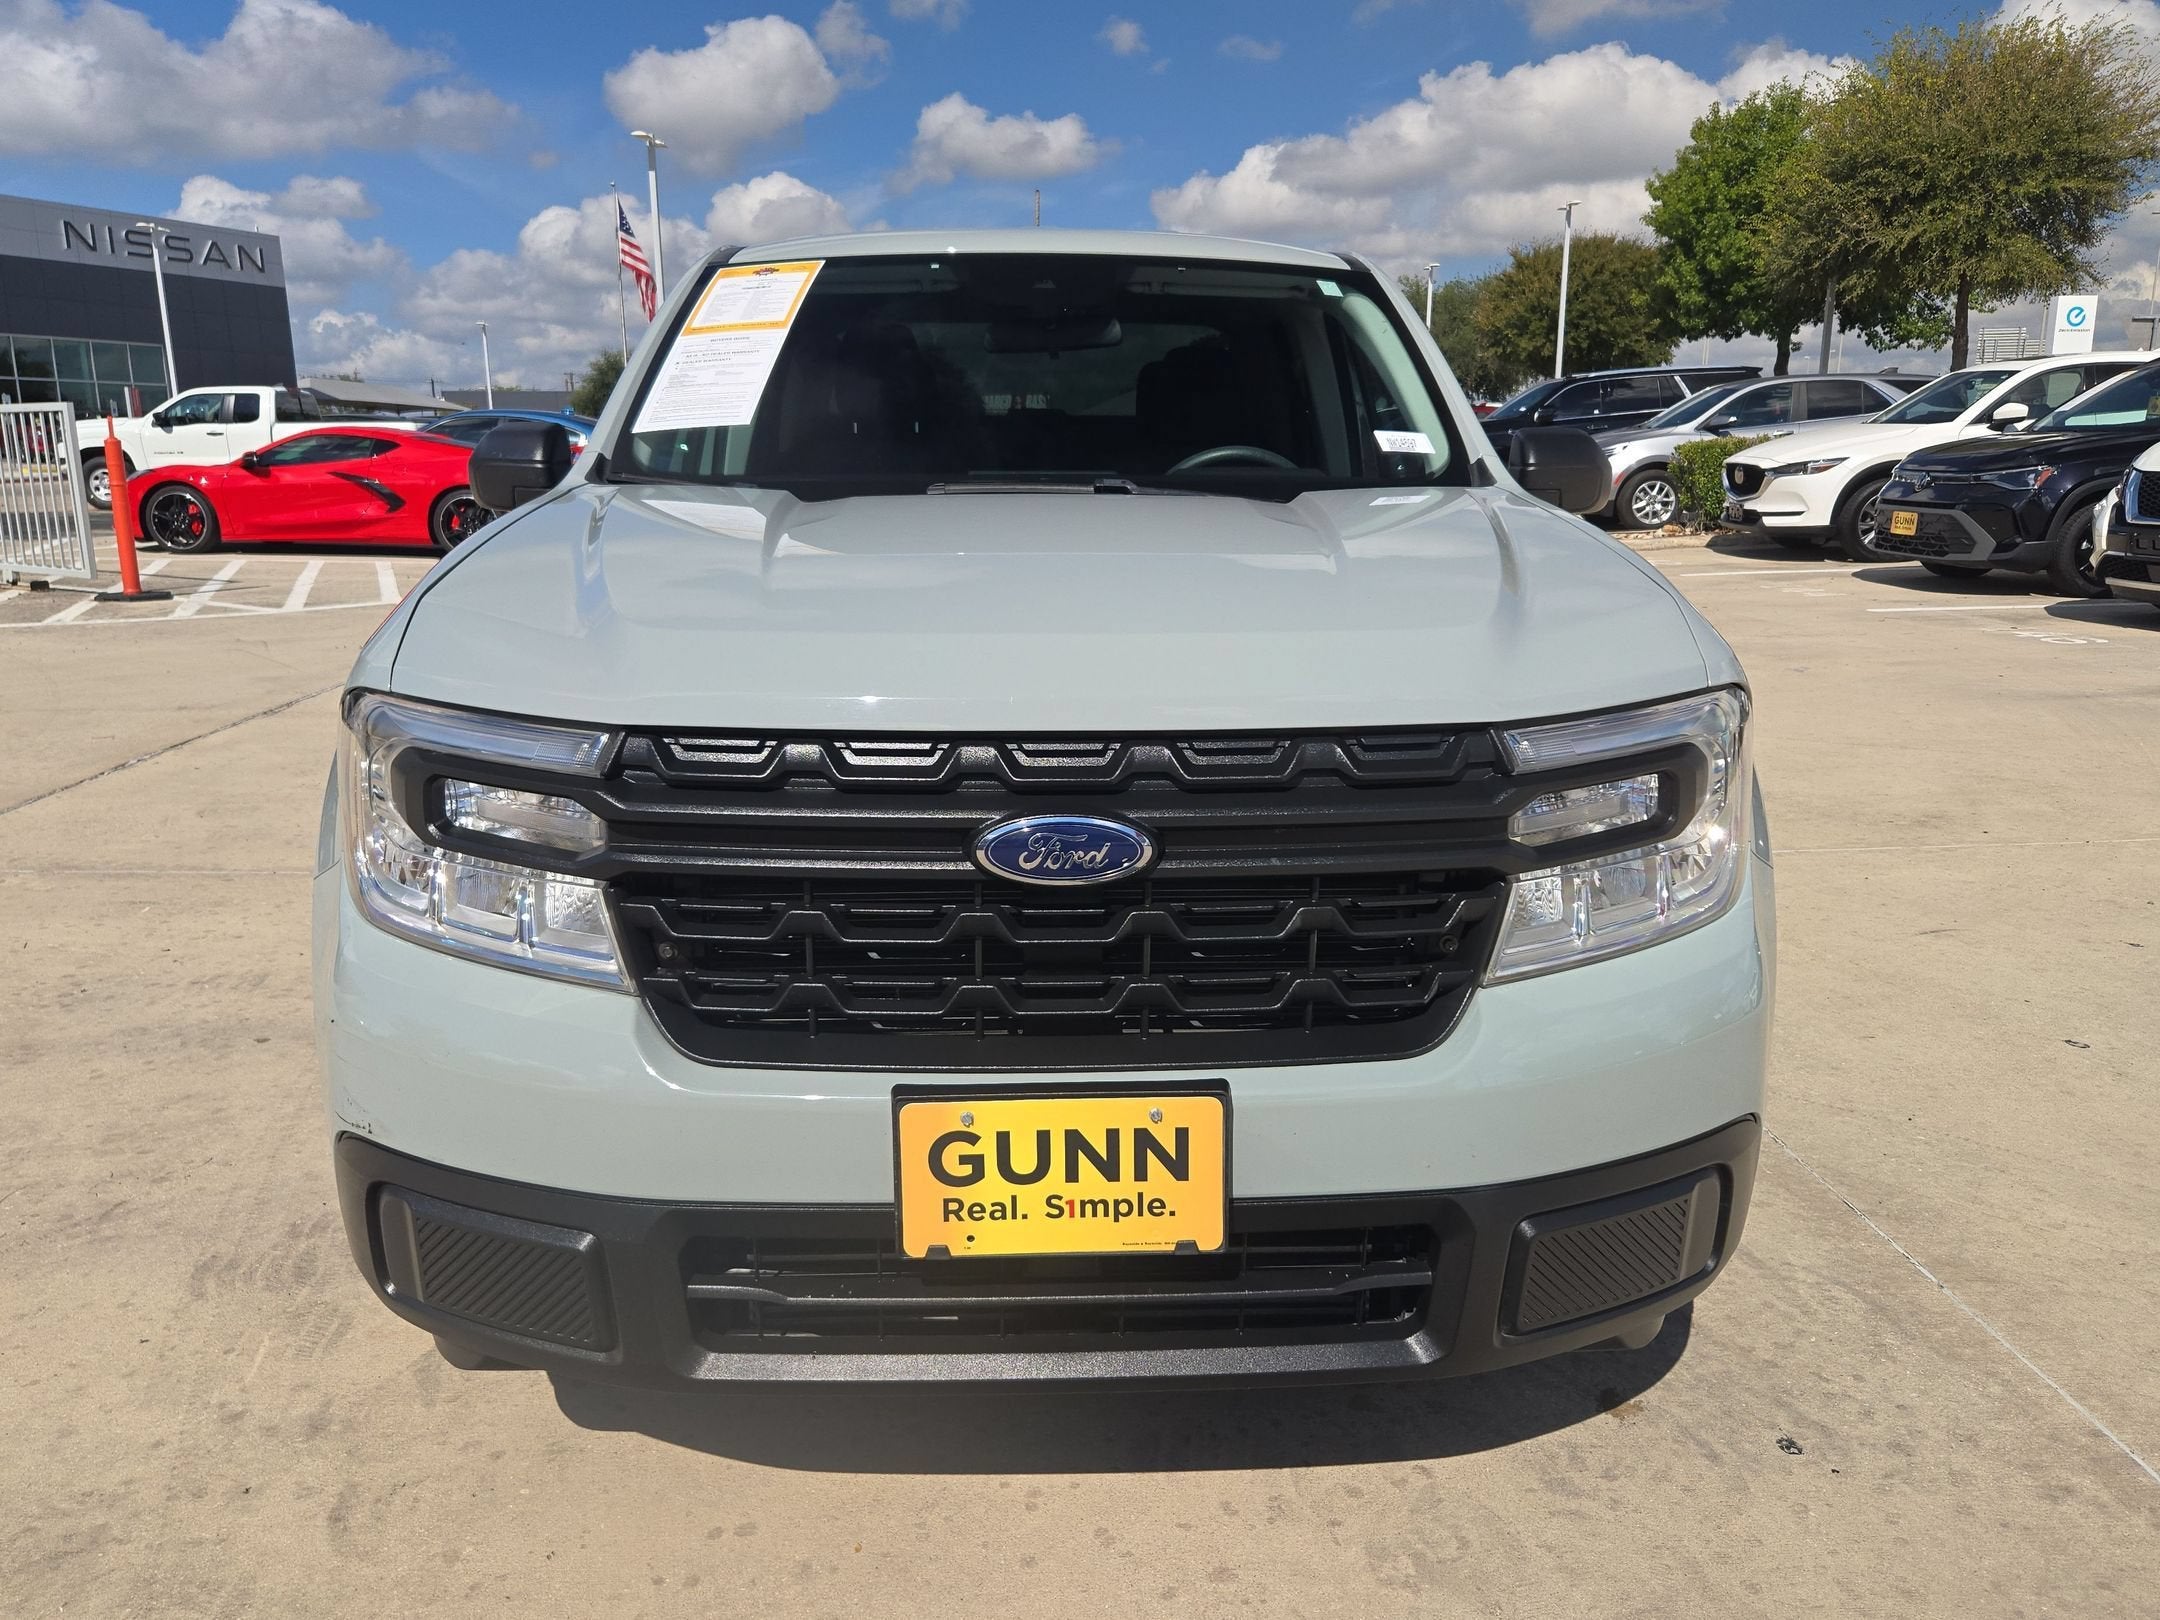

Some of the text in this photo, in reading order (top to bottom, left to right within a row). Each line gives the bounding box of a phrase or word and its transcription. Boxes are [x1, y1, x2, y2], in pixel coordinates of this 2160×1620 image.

[62, 219, 266, 273] NISSAN
[1894, 516, 1915, 526] GUNN
[1018, 832, 1112, 871] Ford
[928, 1126, 1190, 1188] GUNN
[942, 1192, 1177, 1223] Real. S1mple.
